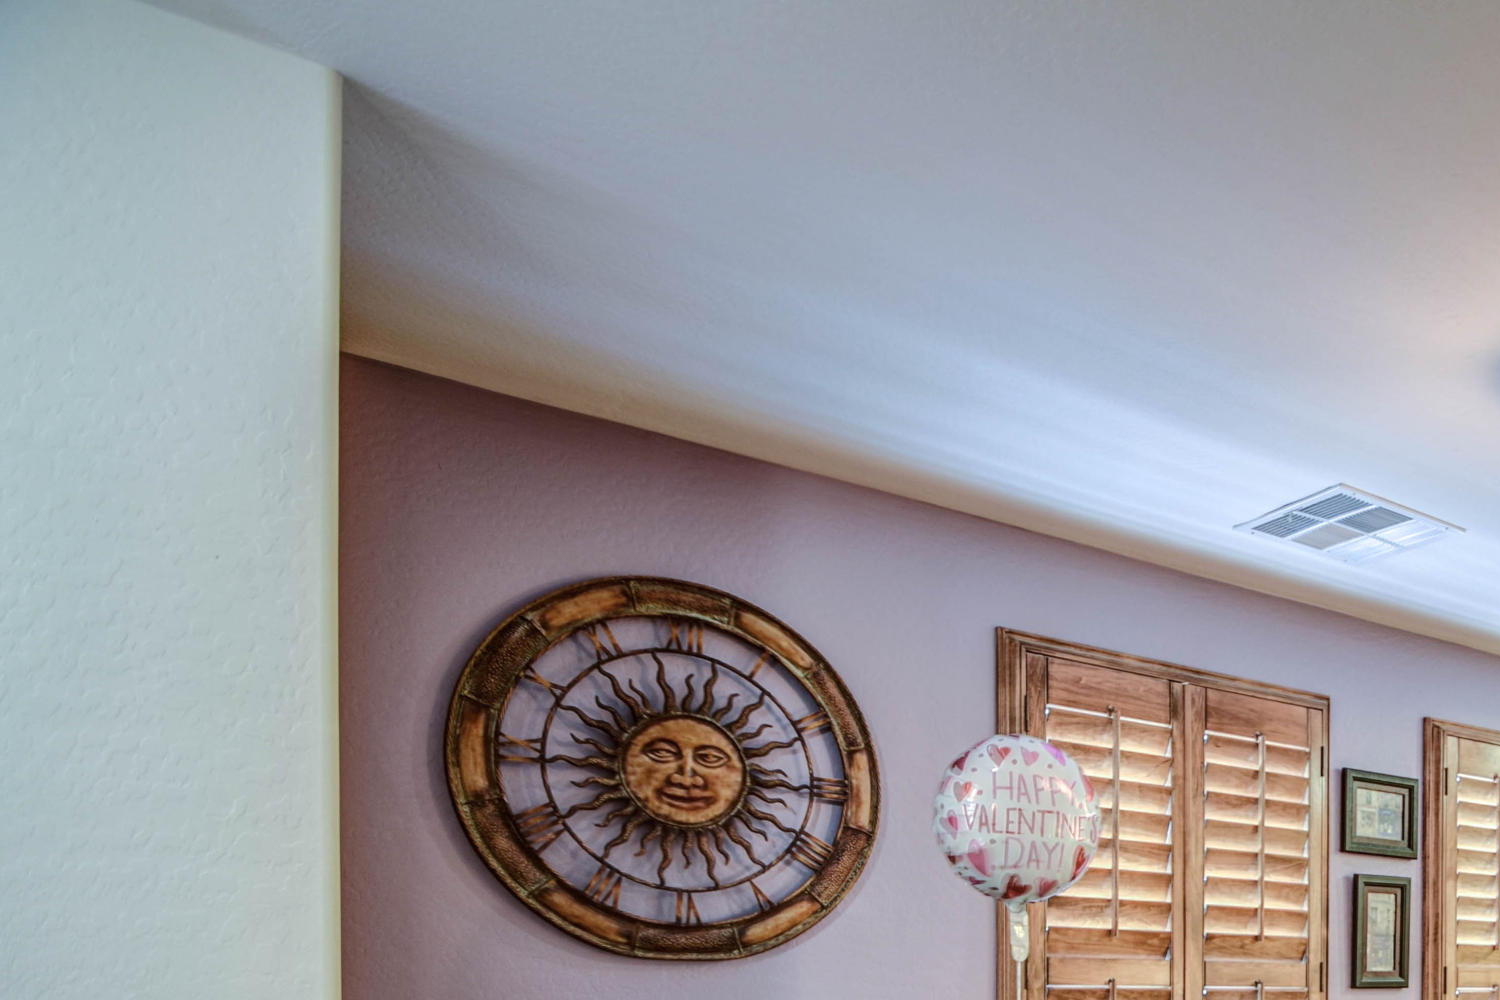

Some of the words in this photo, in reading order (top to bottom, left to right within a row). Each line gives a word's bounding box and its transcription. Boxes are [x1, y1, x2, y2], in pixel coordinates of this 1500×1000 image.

[584, 621, 623, 662] XI
[665, 618, 704, 654] XII
[522, 664, 568, 702] X
[991, 771, 1077, 807] HAPPY
[963, 804, 1100, 844] VALENTINE'S
[997, 837, 1066, 873] DAY!
